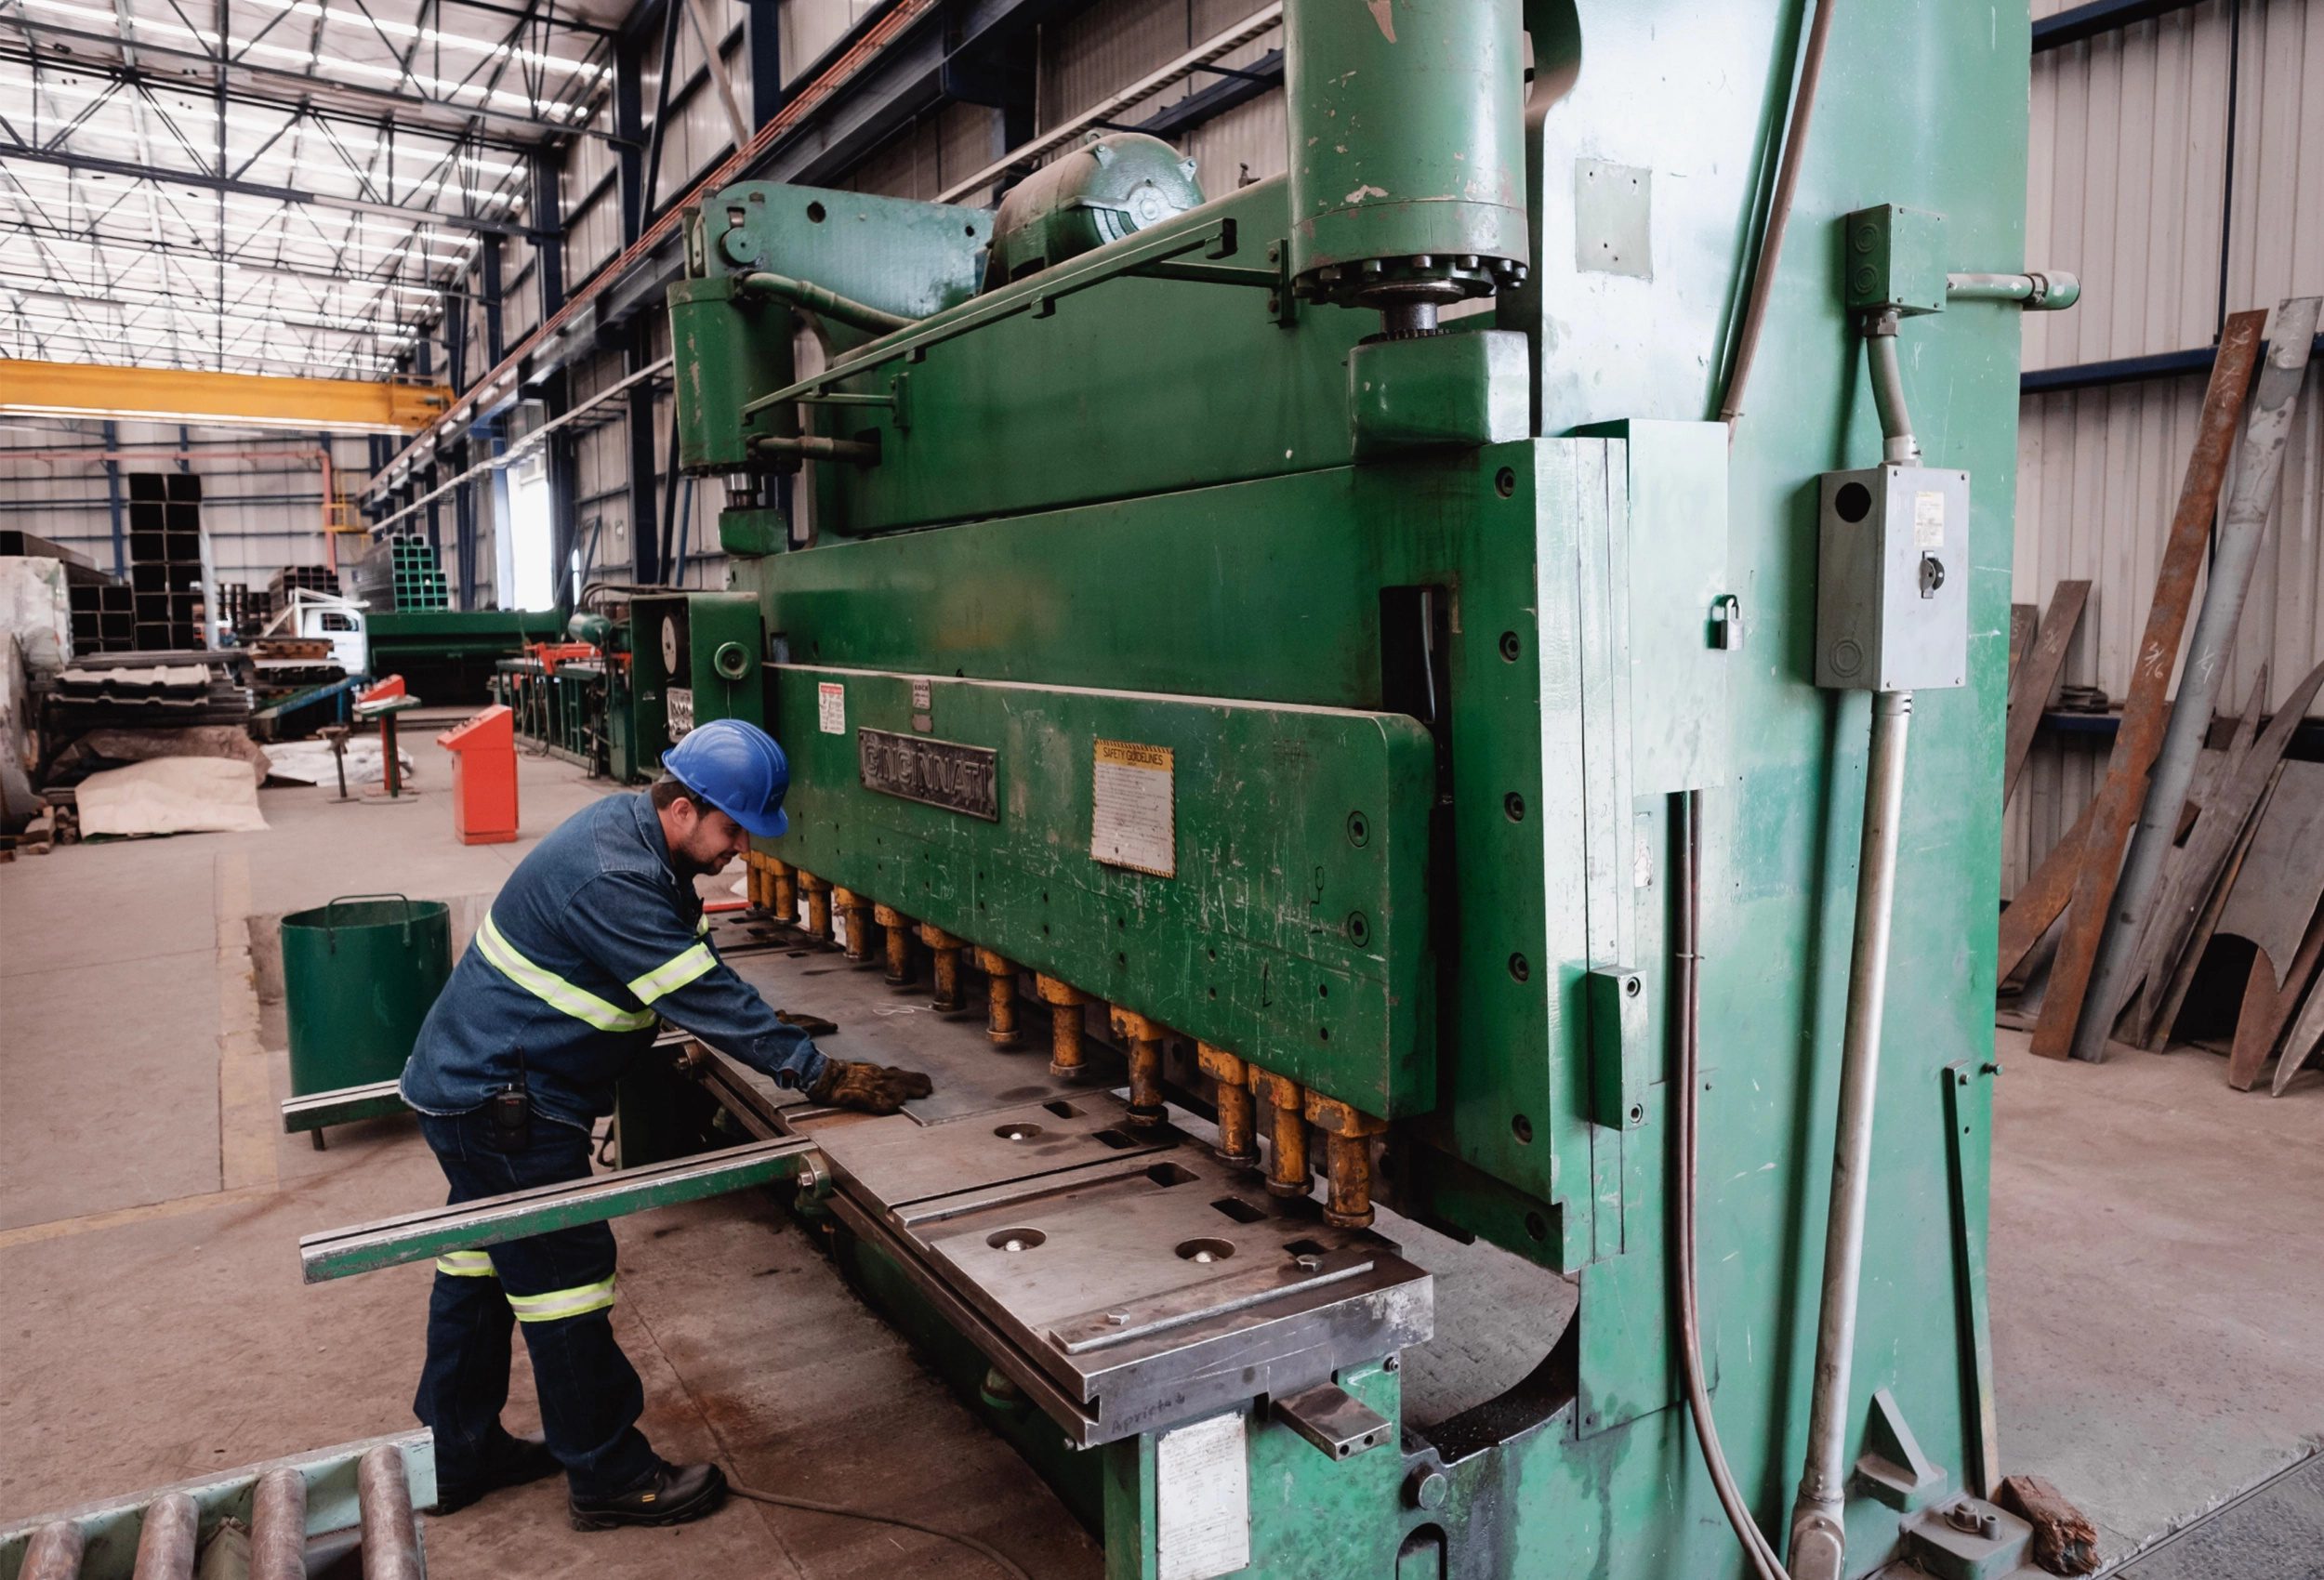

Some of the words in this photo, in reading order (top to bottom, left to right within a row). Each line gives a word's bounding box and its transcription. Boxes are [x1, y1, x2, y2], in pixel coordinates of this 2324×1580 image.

[864, 743, 989, 805] CINCINNATI
[1103, 746, 1126, 760] SAFETY
[1126, 749, 1164, 766] GUIDELINES
